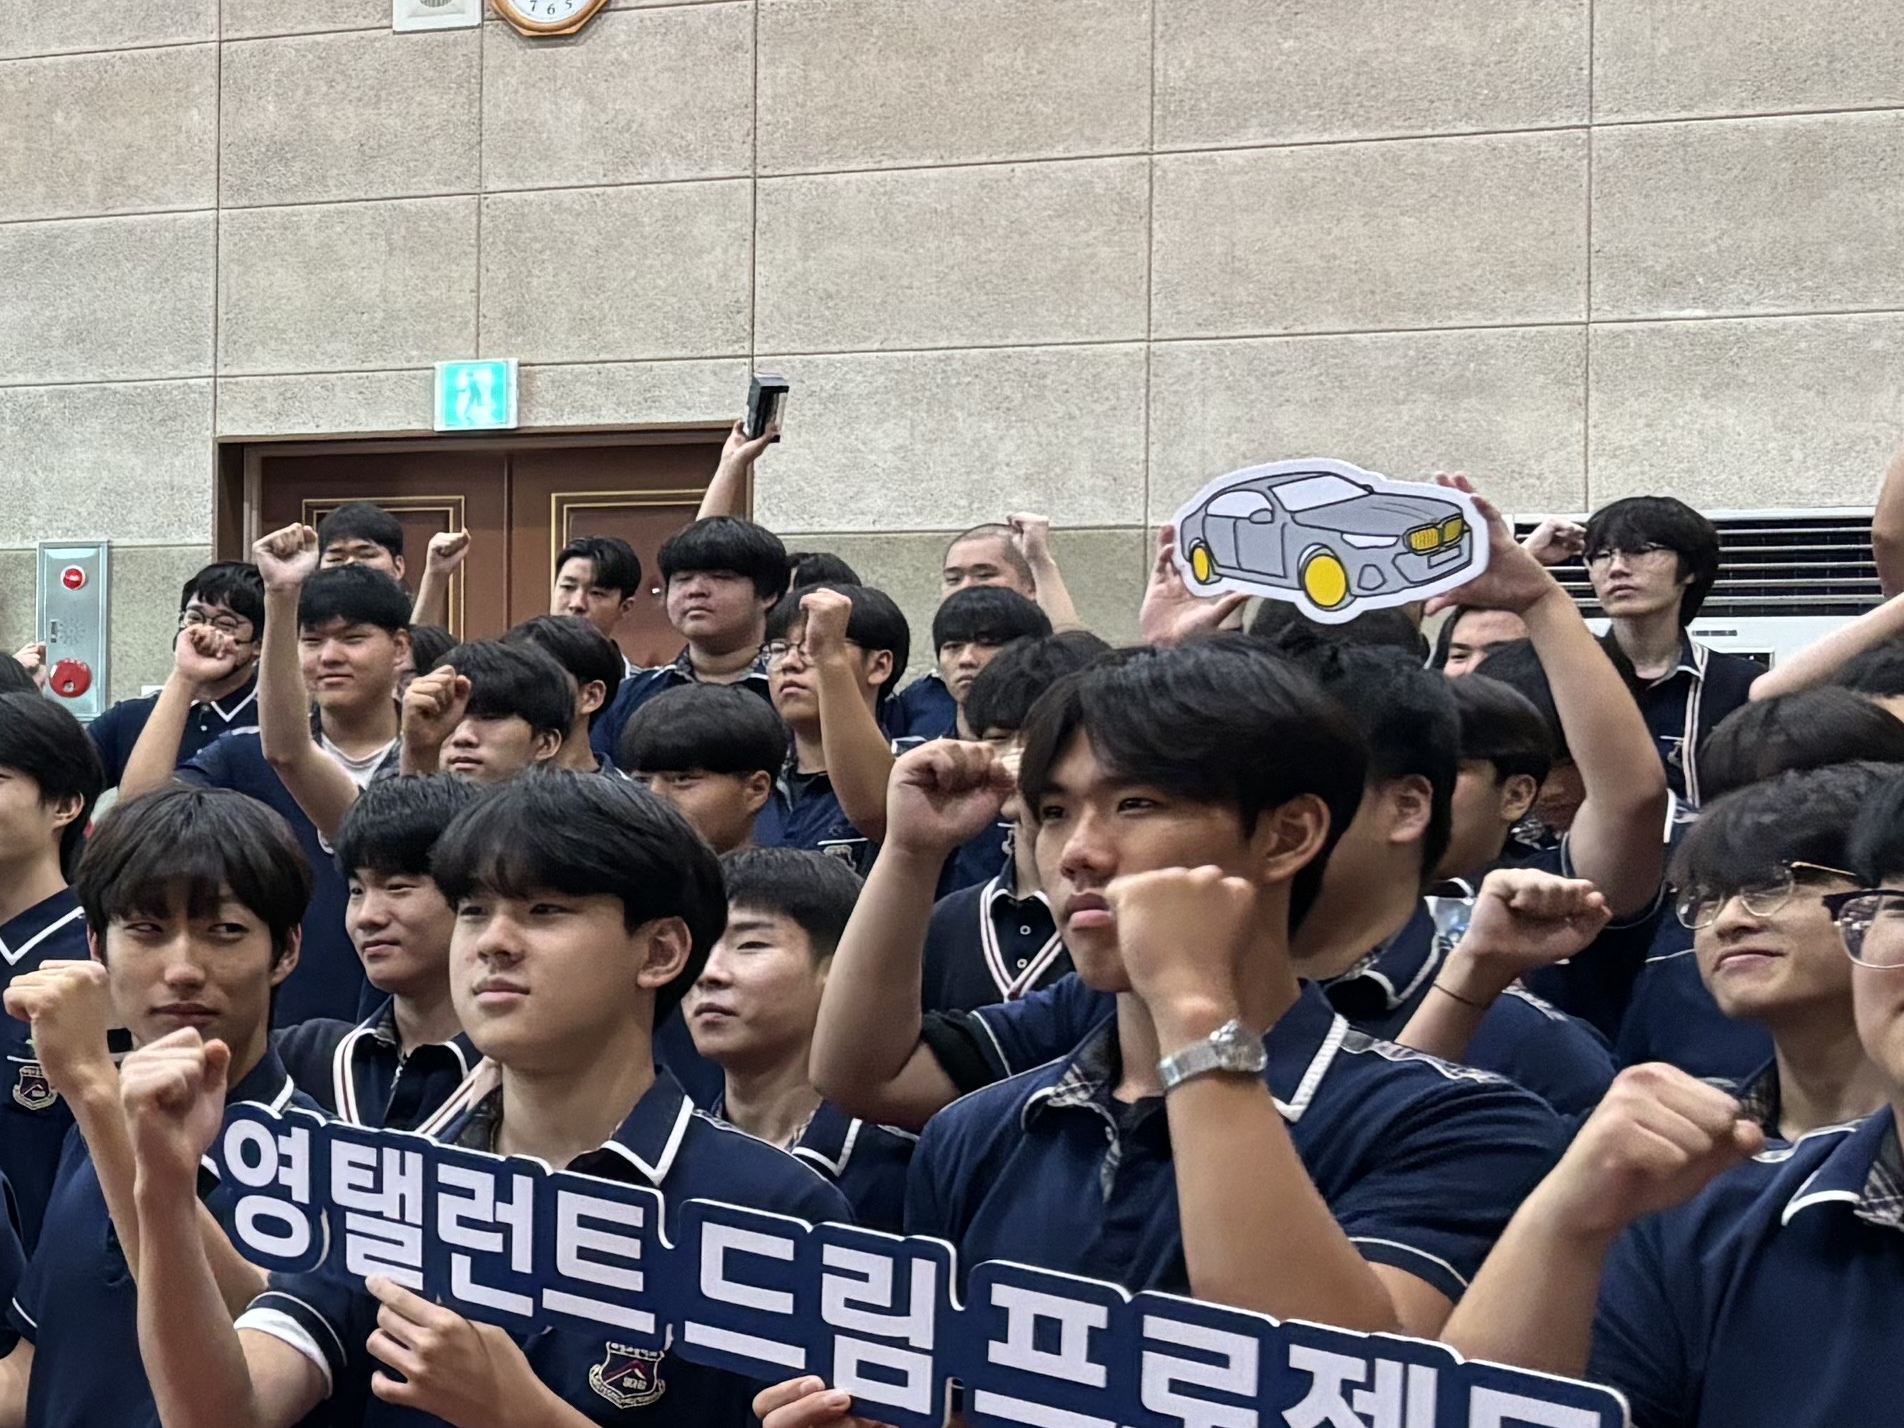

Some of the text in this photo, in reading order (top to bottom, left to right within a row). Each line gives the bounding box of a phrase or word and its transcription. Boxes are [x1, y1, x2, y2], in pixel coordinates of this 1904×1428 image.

[530, 0, 537, 11] 7
[547, 4, 555, 14] 6
[222, 1117, 656, 1333] 영탤런트
[684, 1217, 933, 1415] 드림
